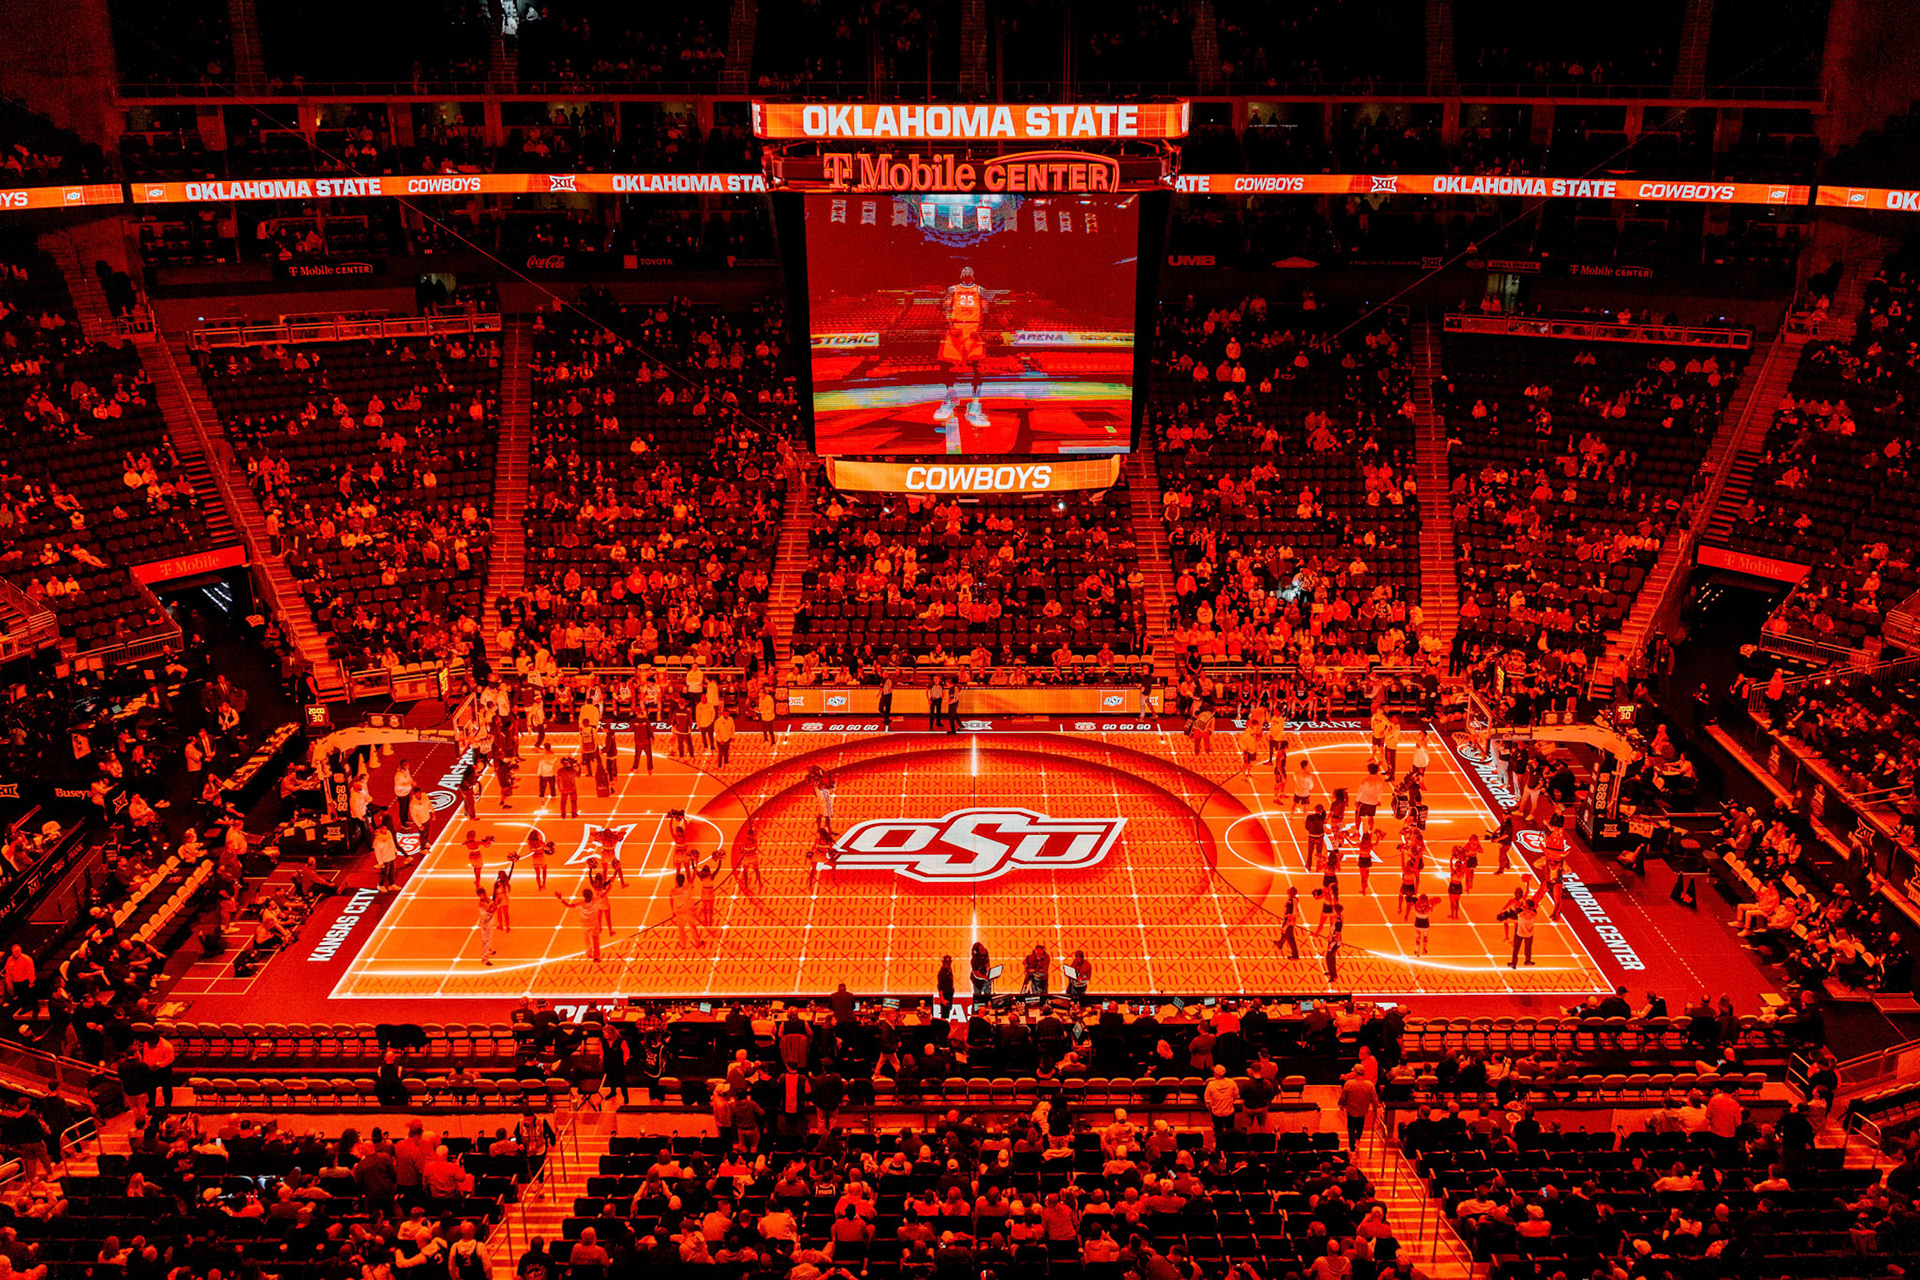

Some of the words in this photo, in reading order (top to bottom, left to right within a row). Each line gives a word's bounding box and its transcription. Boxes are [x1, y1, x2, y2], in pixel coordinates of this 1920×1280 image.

[802, 105, 1016, 137] OKLAHOMA
[1025, 105, 1139, 137] STATE
[407, 177, 481, 193] COWBOYS
[612, 175, 724, 192] OKLAHOMA
[727, 175, 769, 192] STA
[984, 163, 1109, 192] CENTER
[1234, 177, 1305, 191] COWBOYS
[185, 180, 312, 200] OKLAHOMA
[315, 178, 382, 197] STATE
[1433, 176, 1547, 196] OKLAHOMA
[1551, 179, 1617, 198] STATE
[1638, 183, 1735, 200] COWBOYS
[0, 191, 28, 207] YS
[1886, 191, 1920, 210] OK
[640, 258, 673, 266] TOYOTA
[1168, 255, 1216, 266] UMB
[335, 266, 370, 274] CENTER
[1615, 269, 1650, 278] CENTER
[960, 295, 974, 305] 25
[905, 465, 1053, 491] COWBOYS
[312, 714, 323, 723] 30
[1620, 712, 1631, 720] 30
[822, 807, 1129, 883] OSU
[307, 915, 361, 962] KANSAS
[343, 887, 381, 914] CITY
[1561, 872, 1611, 924] T-MOBILE
[1594, 925, 1646, 971] CENTER
